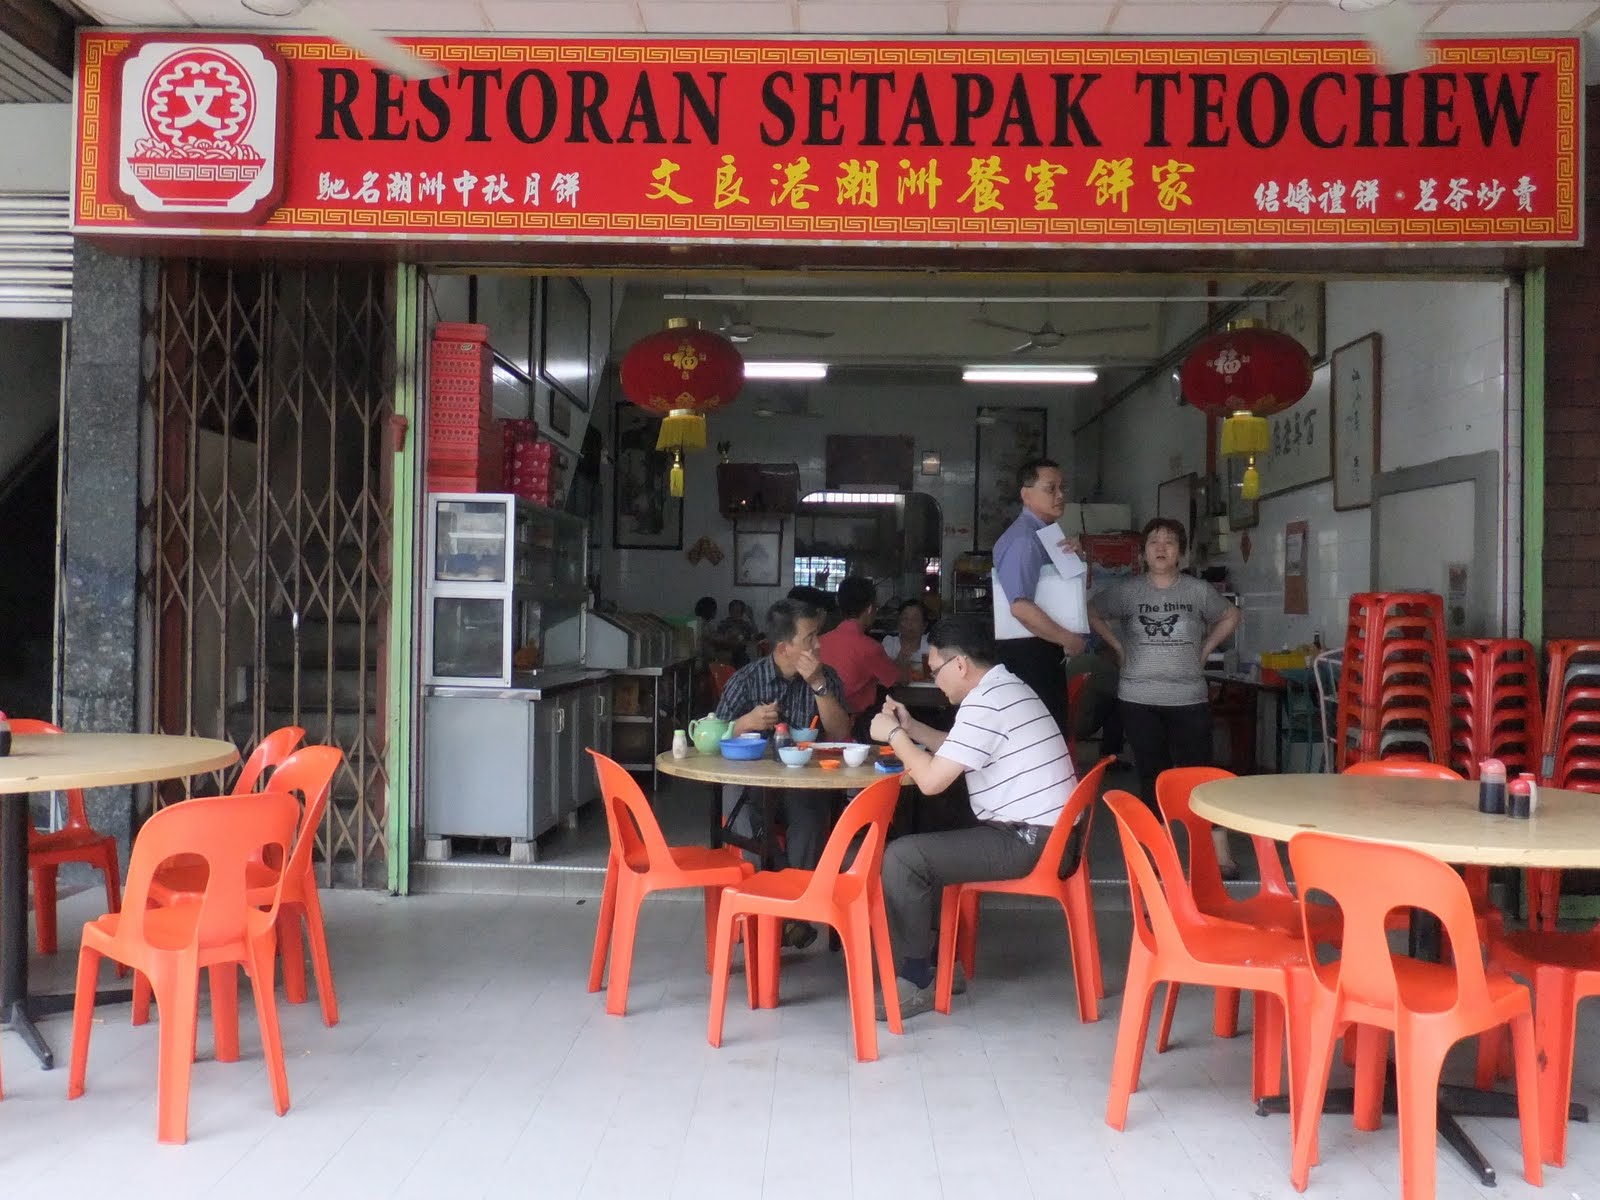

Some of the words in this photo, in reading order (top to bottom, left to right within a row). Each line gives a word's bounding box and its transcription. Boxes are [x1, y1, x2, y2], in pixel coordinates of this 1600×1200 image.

[174, 79, 223, 129] 文
[315, 67, 727, 145] RESTORAN
[761, 70, 1102, 148] SETAPAK
[1135, 71, 1541, 150] TEOCHEW
[1138, 603, 1160, 613] The
[1163, 602, 1193, 613] thing
